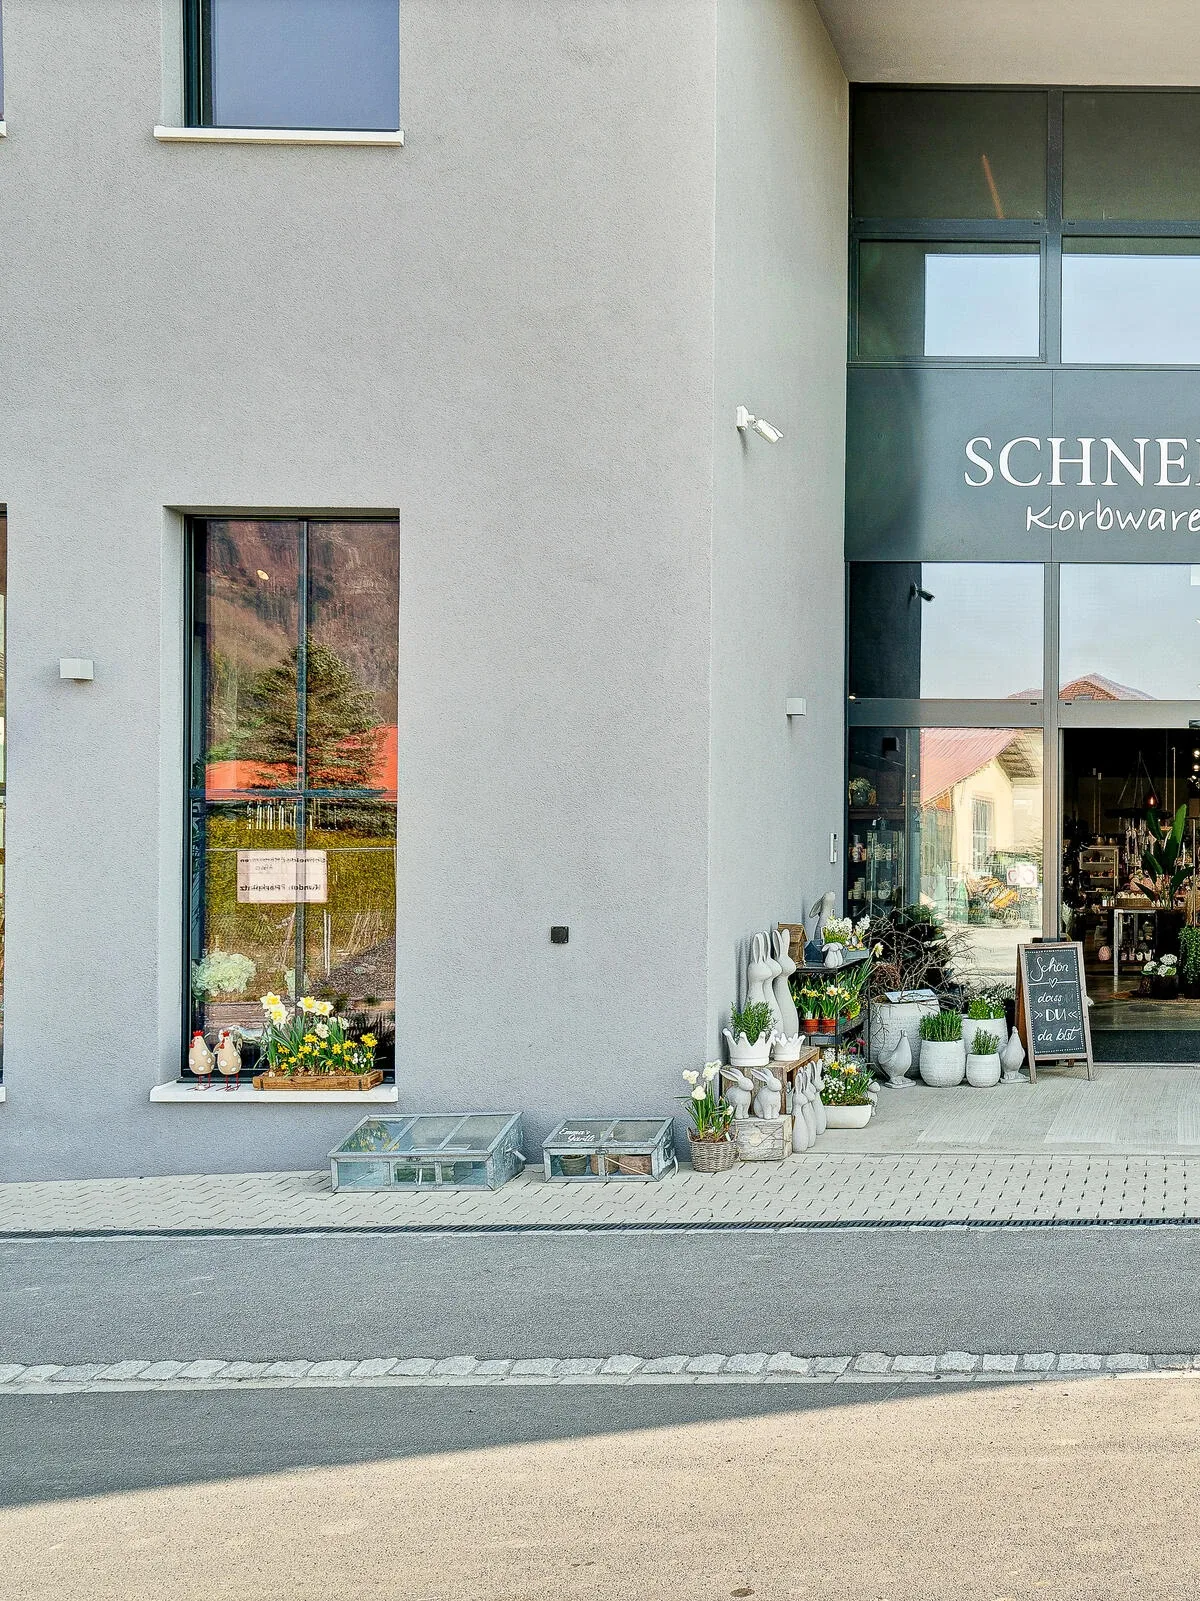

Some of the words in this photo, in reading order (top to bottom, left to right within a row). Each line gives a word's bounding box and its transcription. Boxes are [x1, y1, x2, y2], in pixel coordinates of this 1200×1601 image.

[1030, 956, 1070, 982] Schön
[1037, 992, 1063, 1003] dass
[1037, 1029, 1053, 1041] da
[1056, 1026, 1081, 1041] bist
